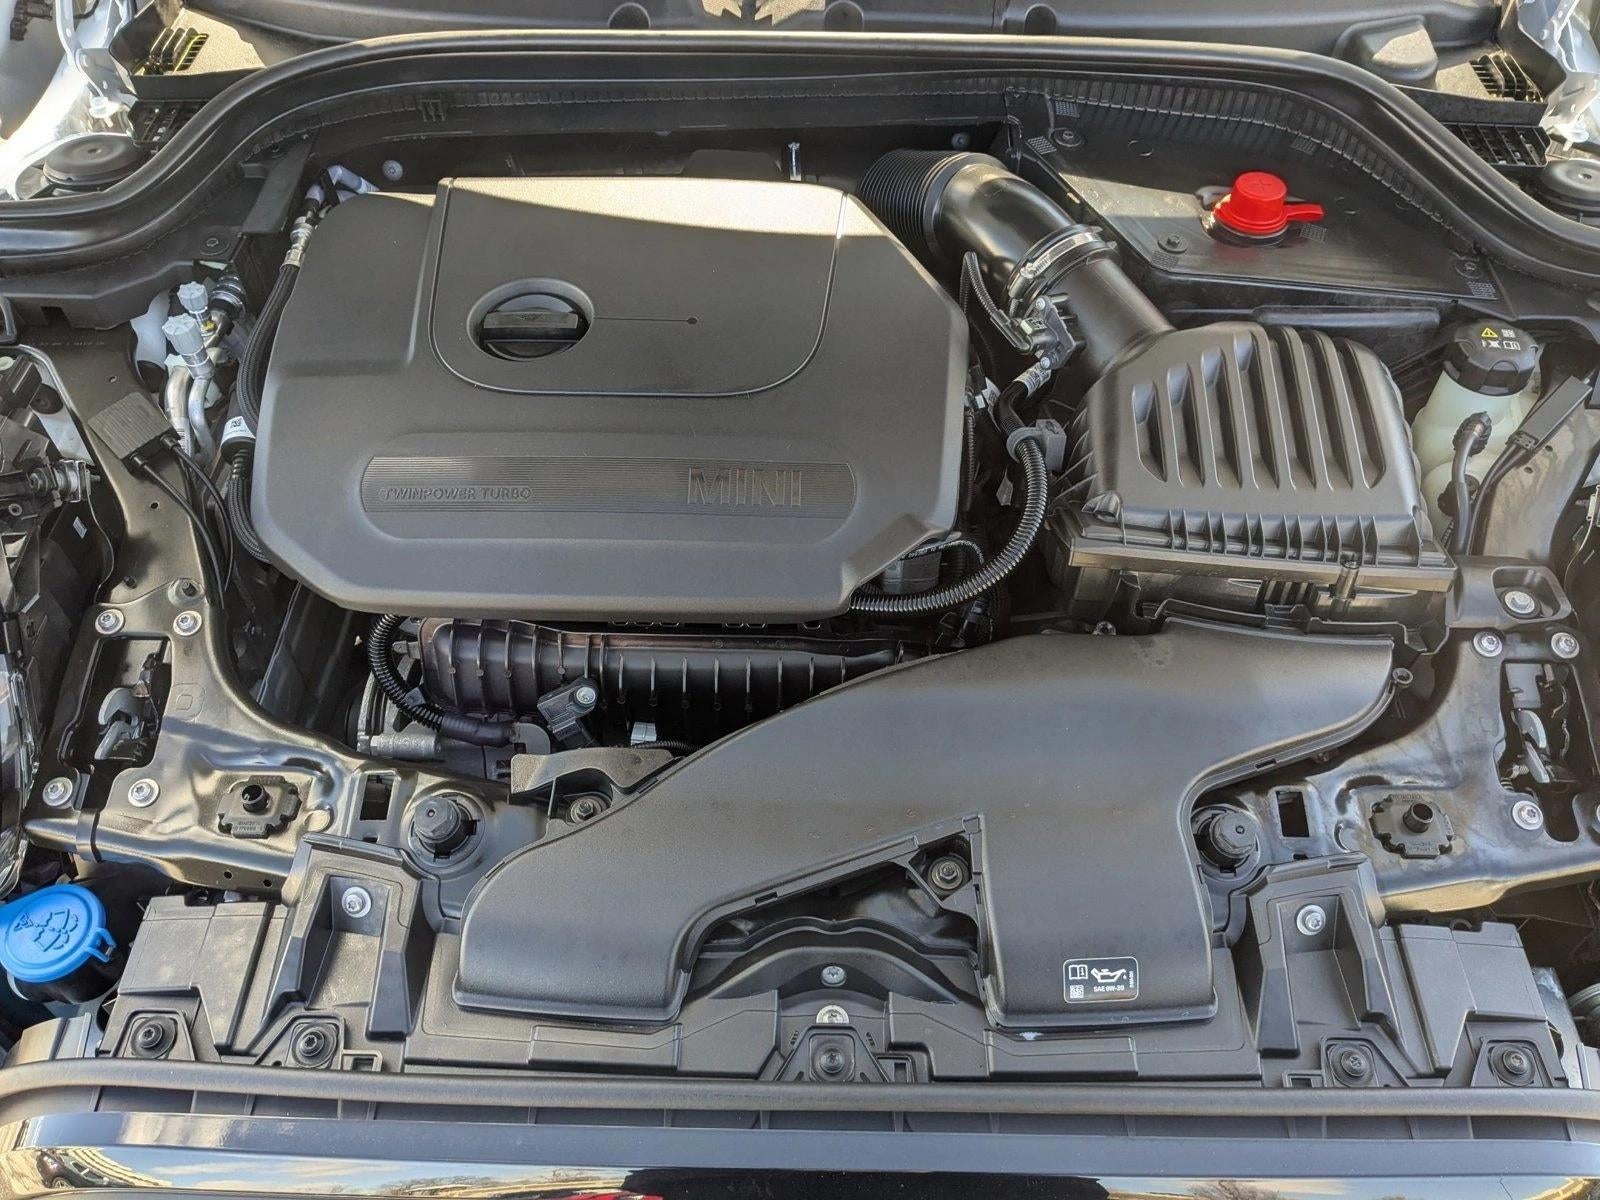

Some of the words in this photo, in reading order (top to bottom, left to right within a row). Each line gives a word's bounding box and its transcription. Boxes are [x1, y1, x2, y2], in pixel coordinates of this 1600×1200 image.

[380, 486, 476, 500] TWINPOWER
[479, 487, 533, 500] TURBO
[687, 467, 801, 507] MINI
[1105, 984, 1125, 992] 0W-20
